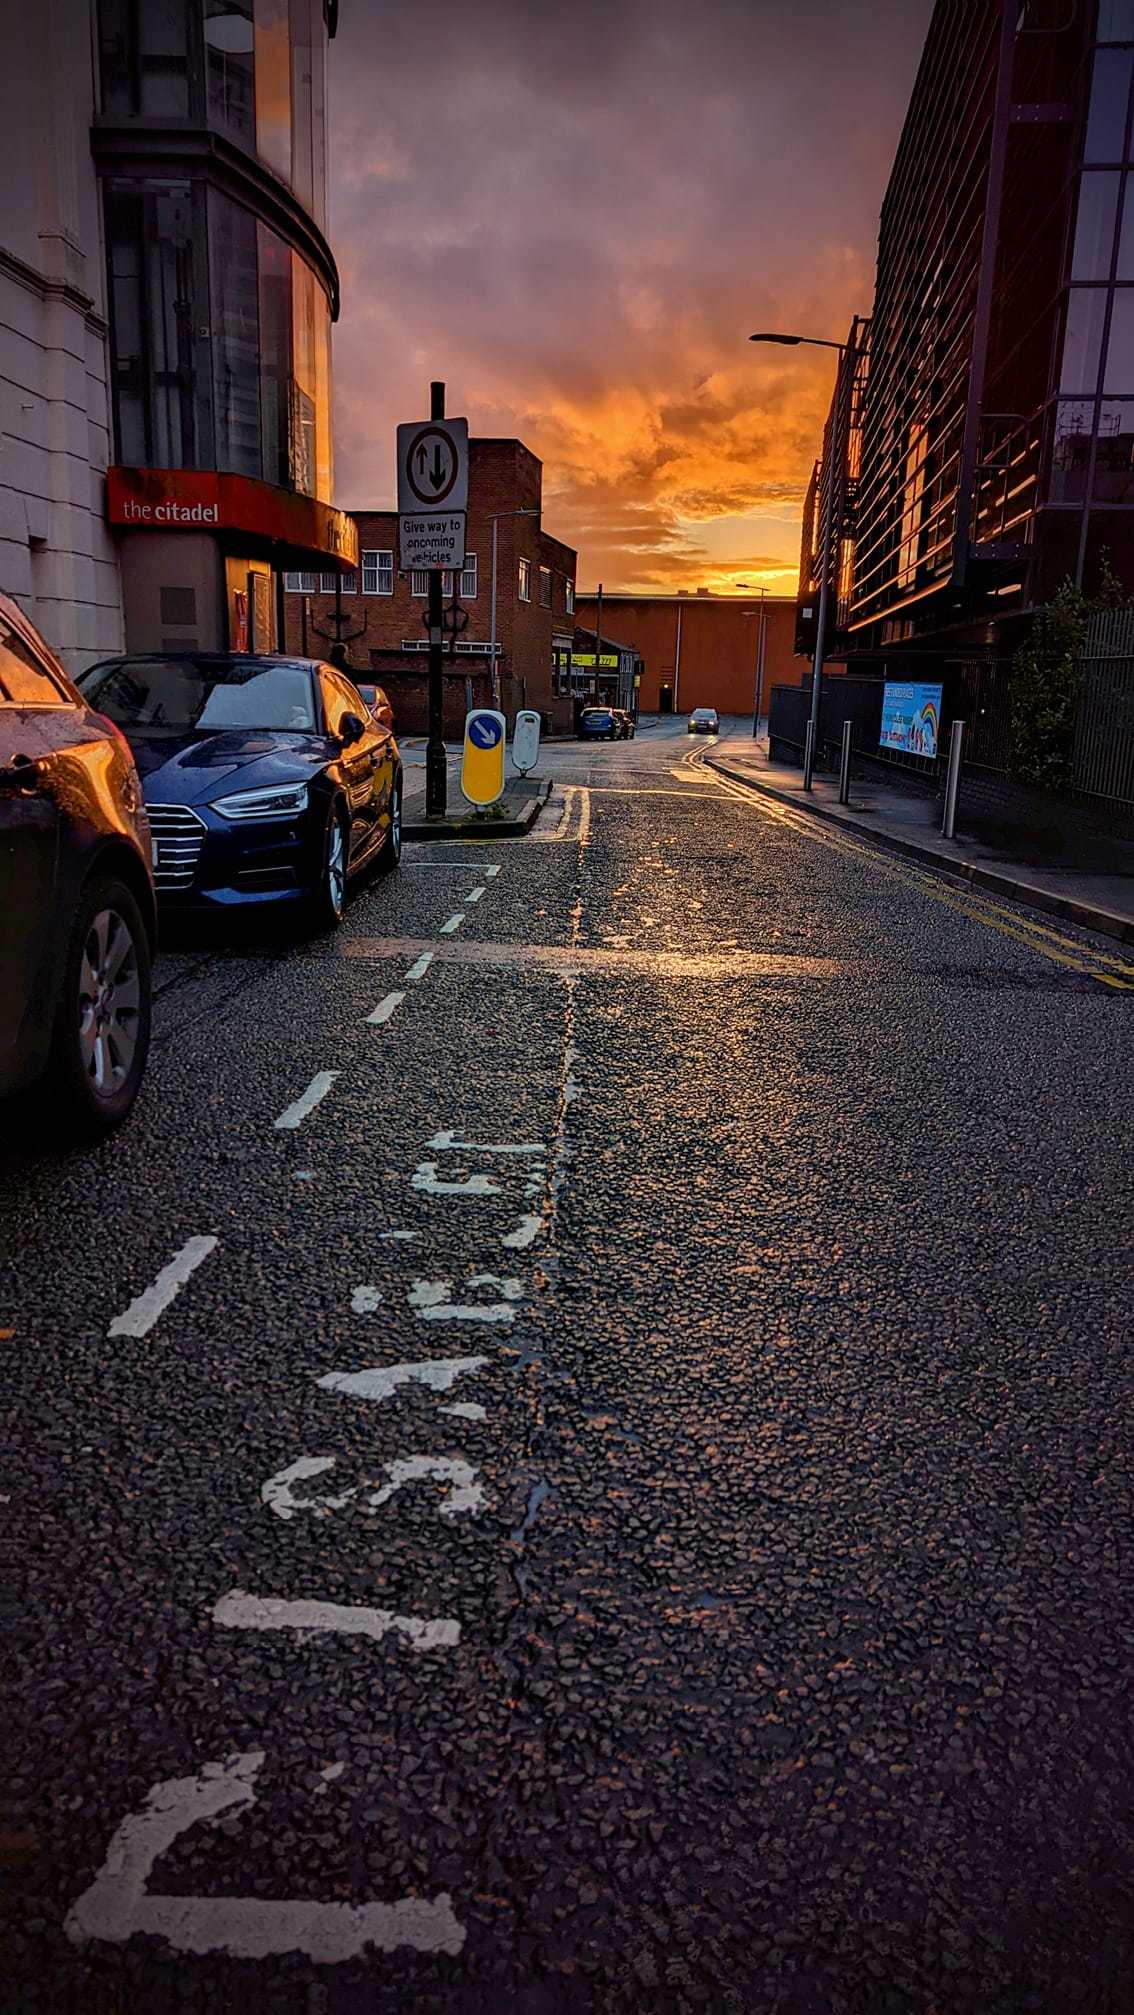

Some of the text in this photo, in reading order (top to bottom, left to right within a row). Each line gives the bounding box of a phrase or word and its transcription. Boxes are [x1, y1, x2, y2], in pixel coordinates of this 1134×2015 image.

[123, 500, 218, 522] the citadel
[403, 519, 461, 533] Give way to
[407, 535, 455, 548] oncoming
